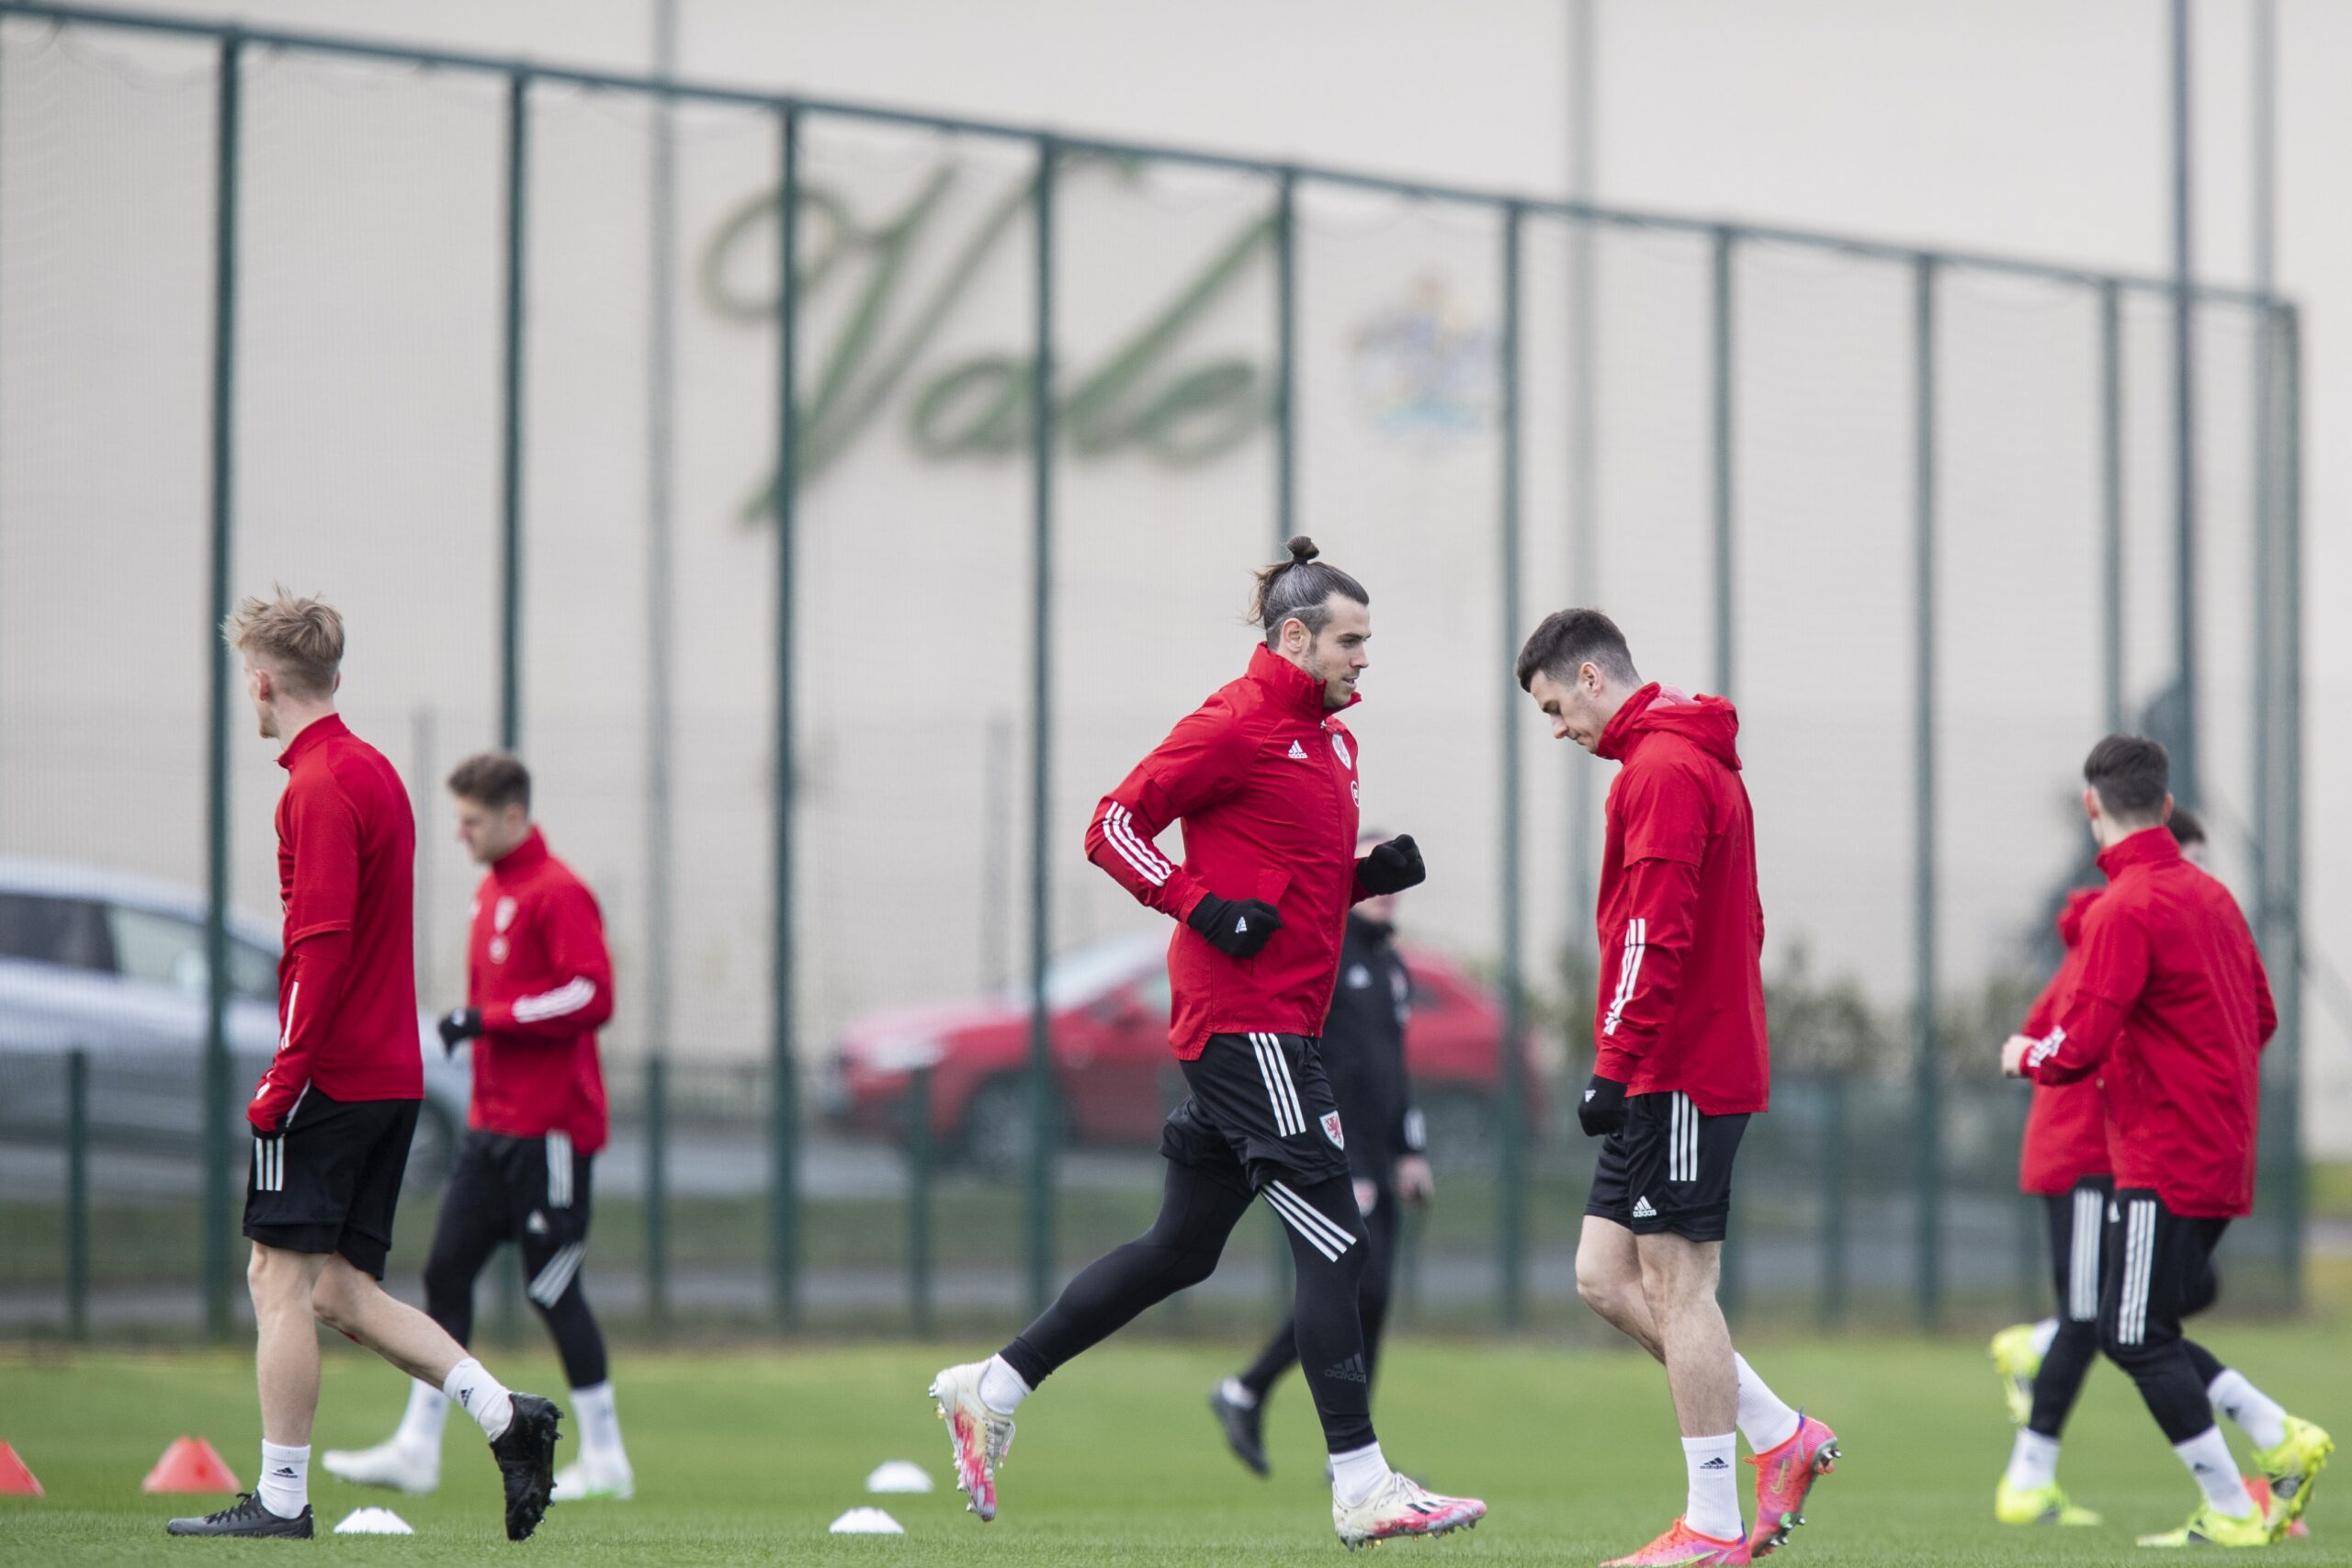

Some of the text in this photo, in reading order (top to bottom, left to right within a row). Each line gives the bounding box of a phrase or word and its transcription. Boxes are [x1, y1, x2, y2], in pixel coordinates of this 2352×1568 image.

[700, 154, 1288, 529] Vale
[1633, 1209, 1657, 1217] adidas
[1324, 1368, 1366, 1383] adida
